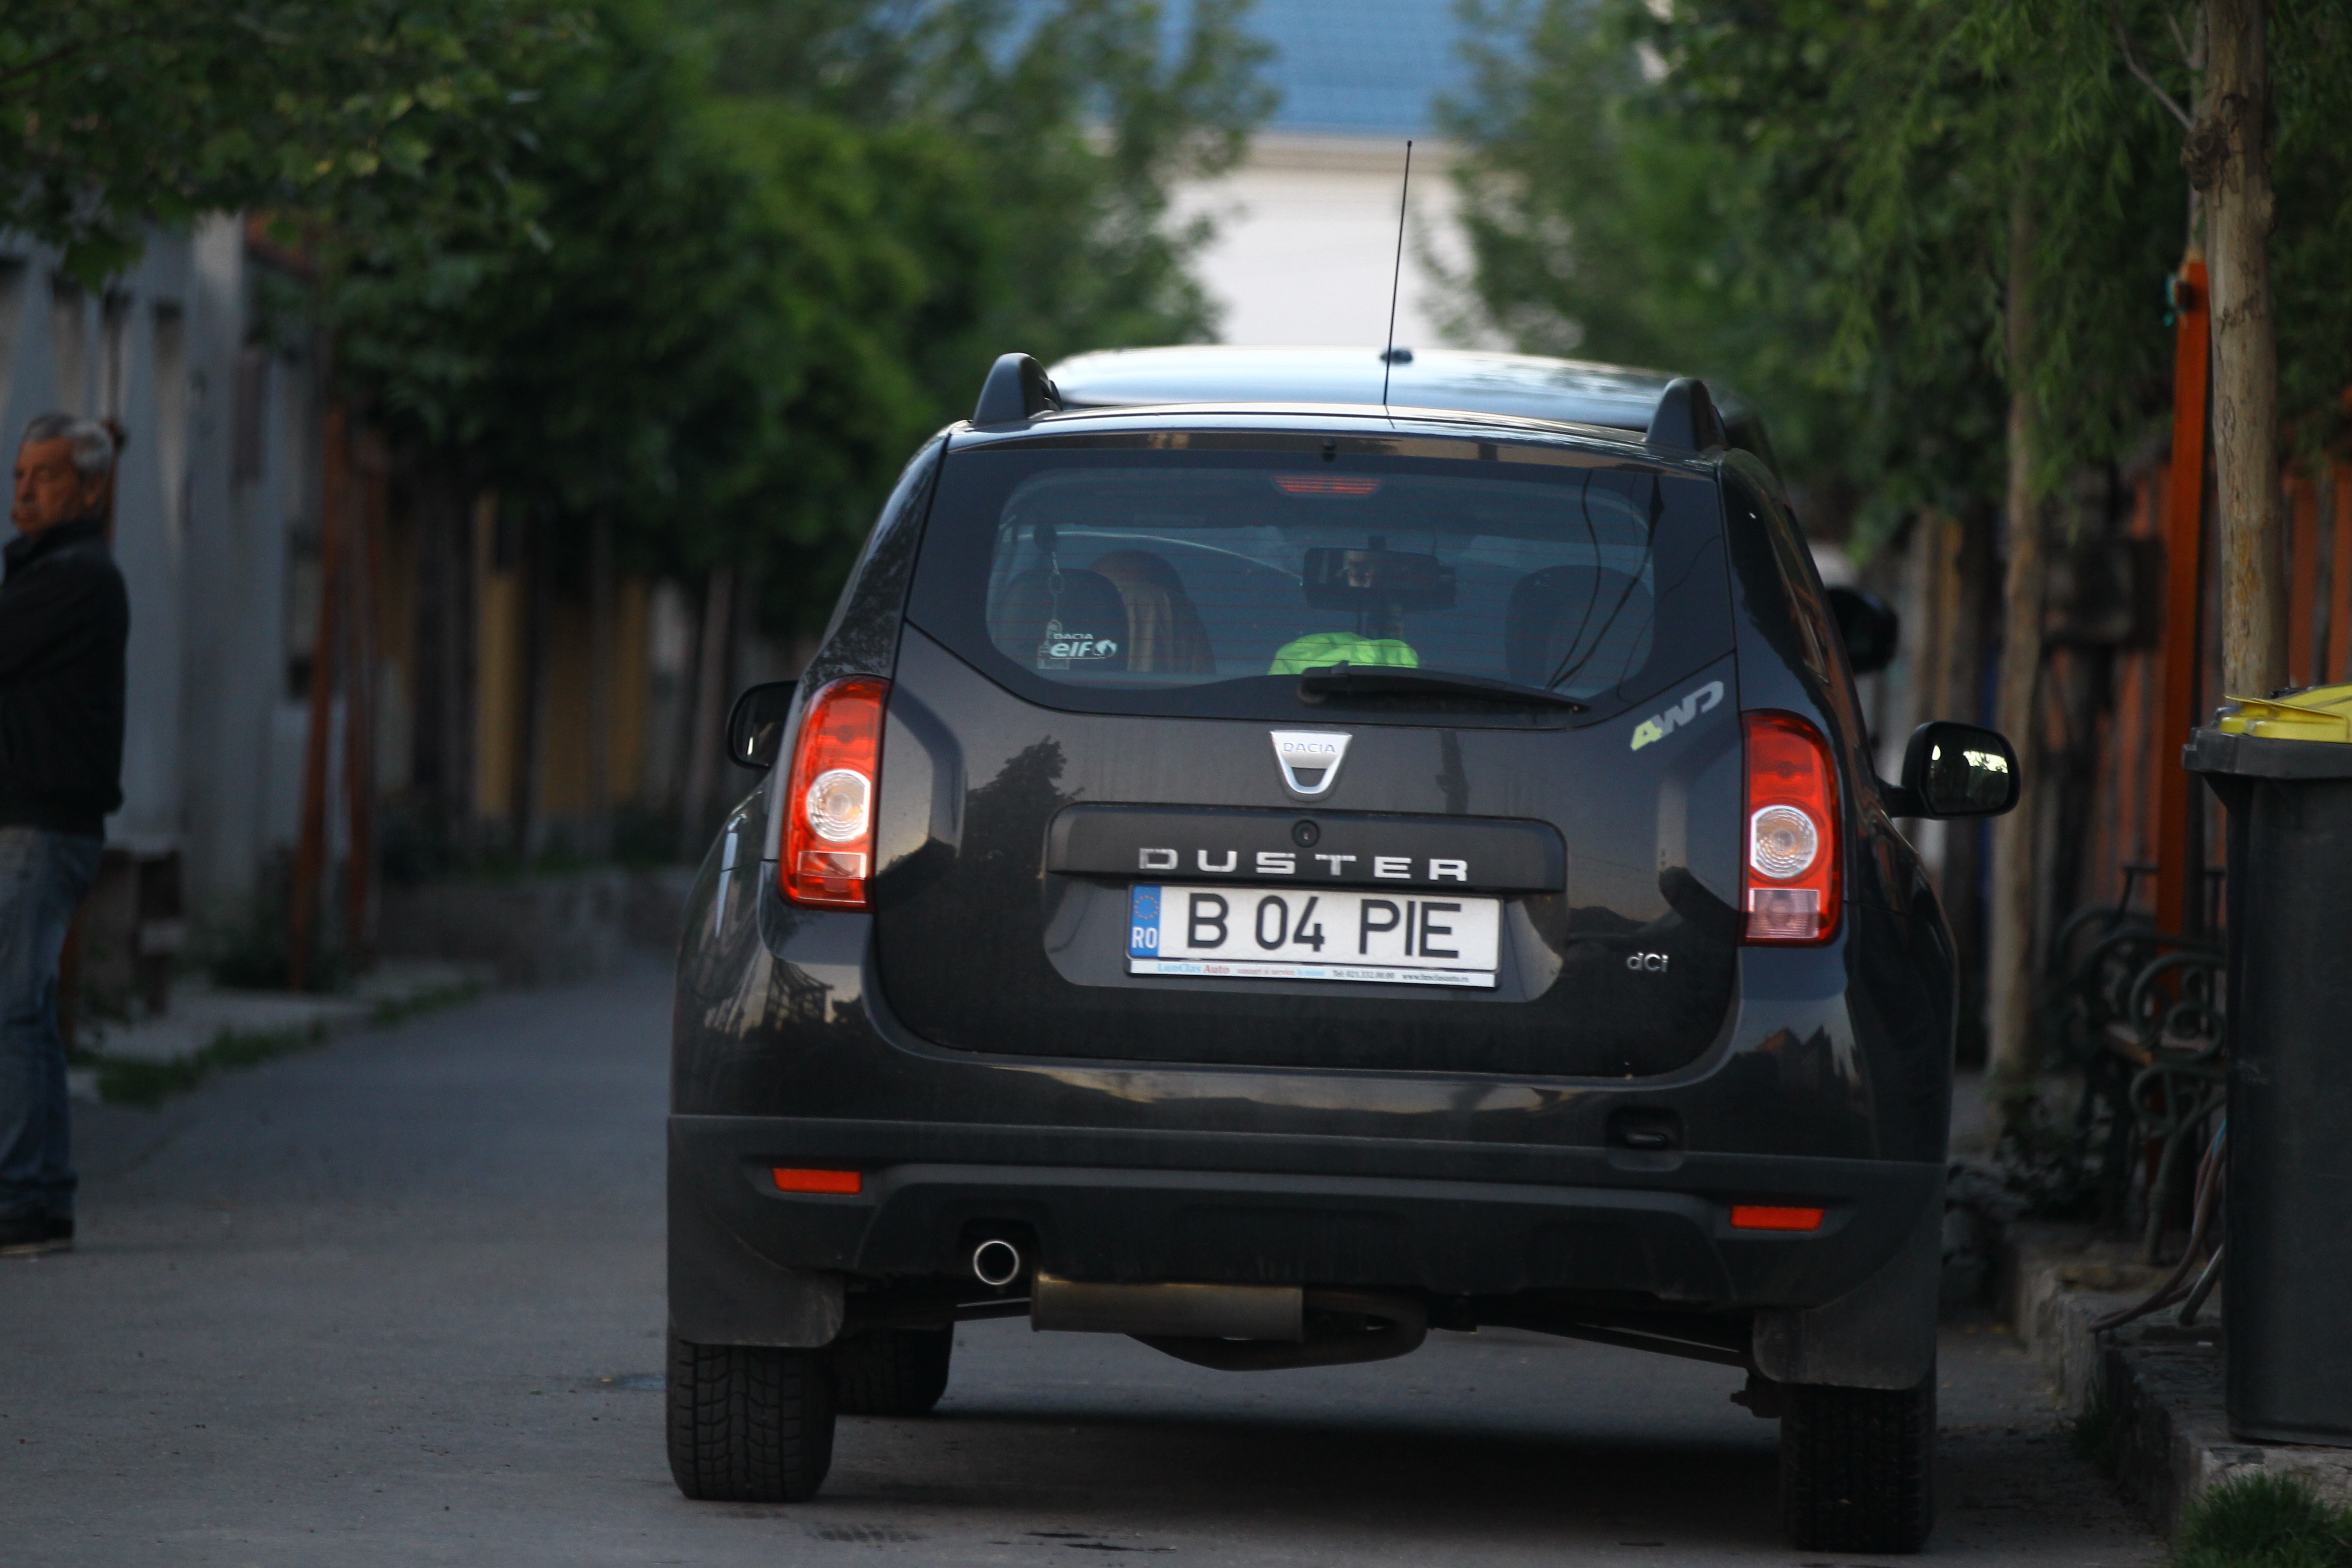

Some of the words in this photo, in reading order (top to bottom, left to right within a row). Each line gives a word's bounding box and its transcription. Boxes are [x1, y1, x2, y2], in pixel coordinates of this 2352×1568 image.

[1050, 641, 1093, 657] elf
[1630, 680, 1725, 751] 4WD
[1283, 742, 1336, 753] DACIA
[1139, 848, 1469, 882] DUSTER
[1187, 893, 1229, 949] B
[1255, 895, 1325, 952] 04
[1359, 898, 1462, 959] PIE
[1131, 927, 1158, 949] RO
[1626, 952, 1669, 973] dCi
